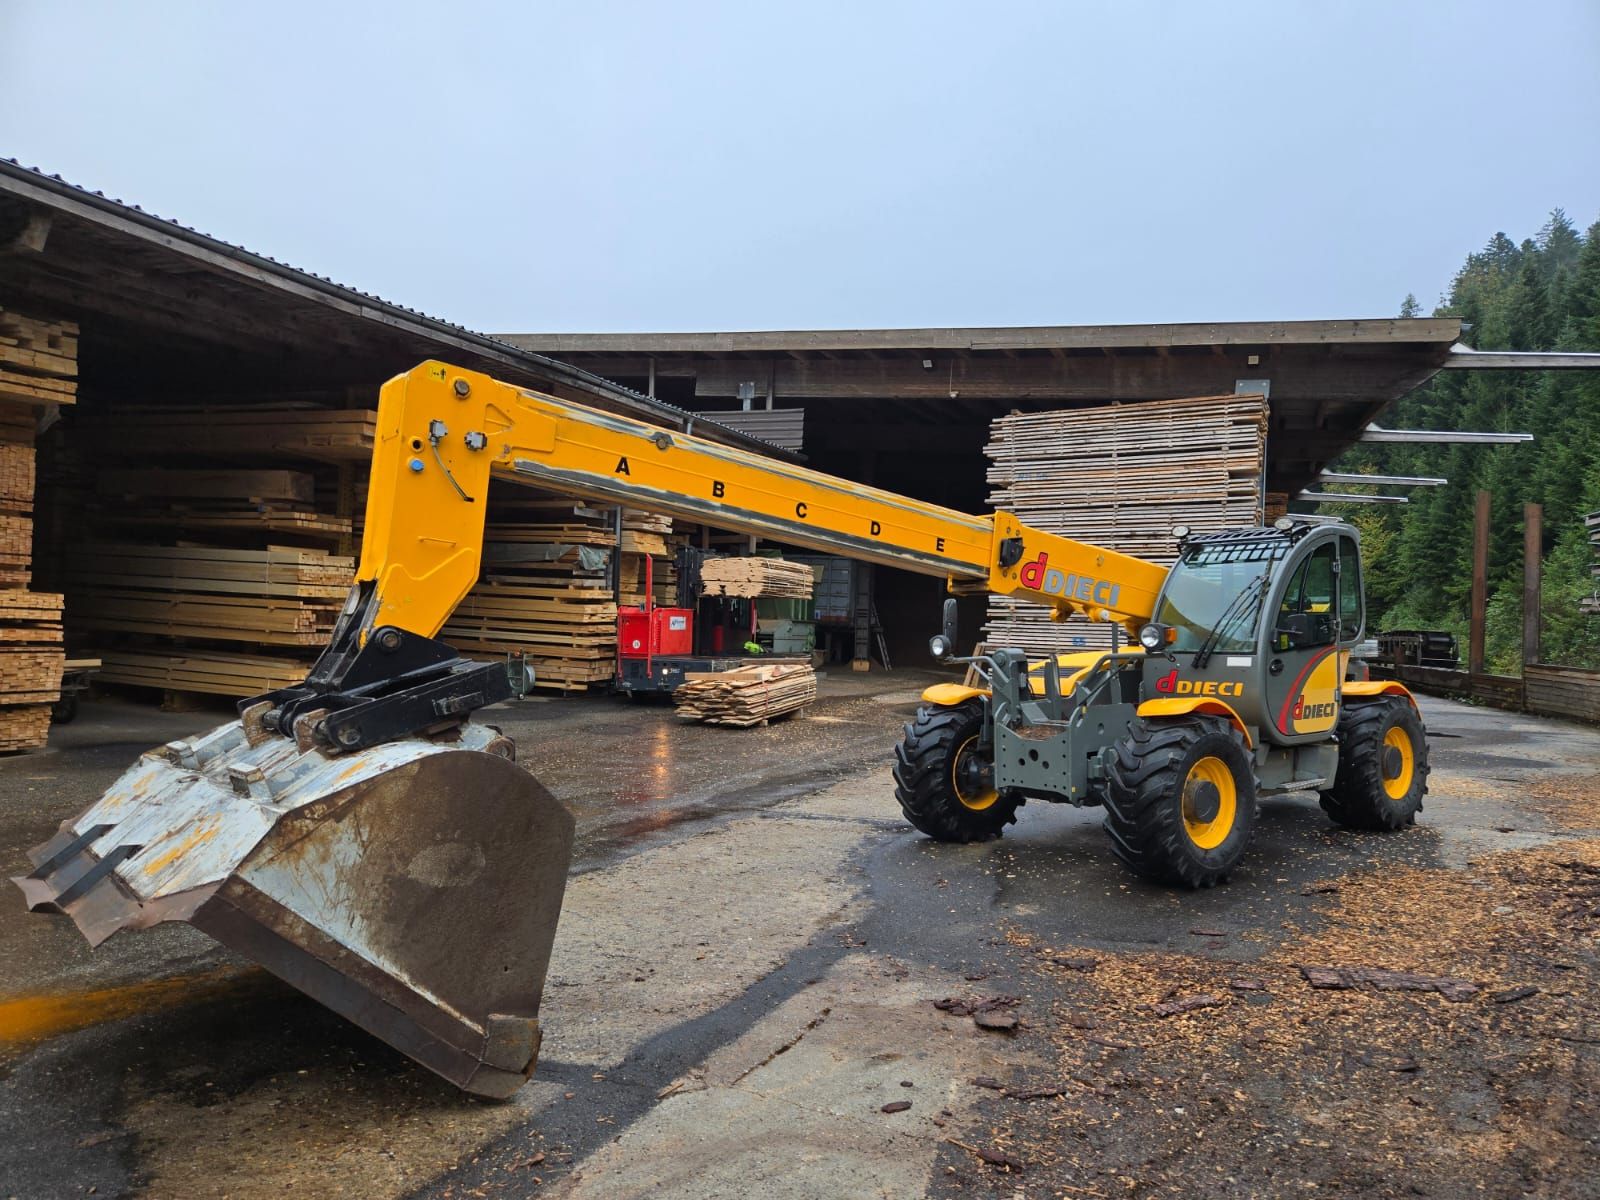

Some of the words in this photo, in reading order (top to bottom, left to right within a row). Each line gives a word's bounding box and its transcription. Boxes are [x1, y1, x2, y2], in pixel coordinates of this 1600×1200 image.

[614, 456, 630, 476] A
[712, 480, 725, 498] B
[795, 502, 808, 519] C
[870, 521, 881, 536] D
[936, 537, 945, 552] E
